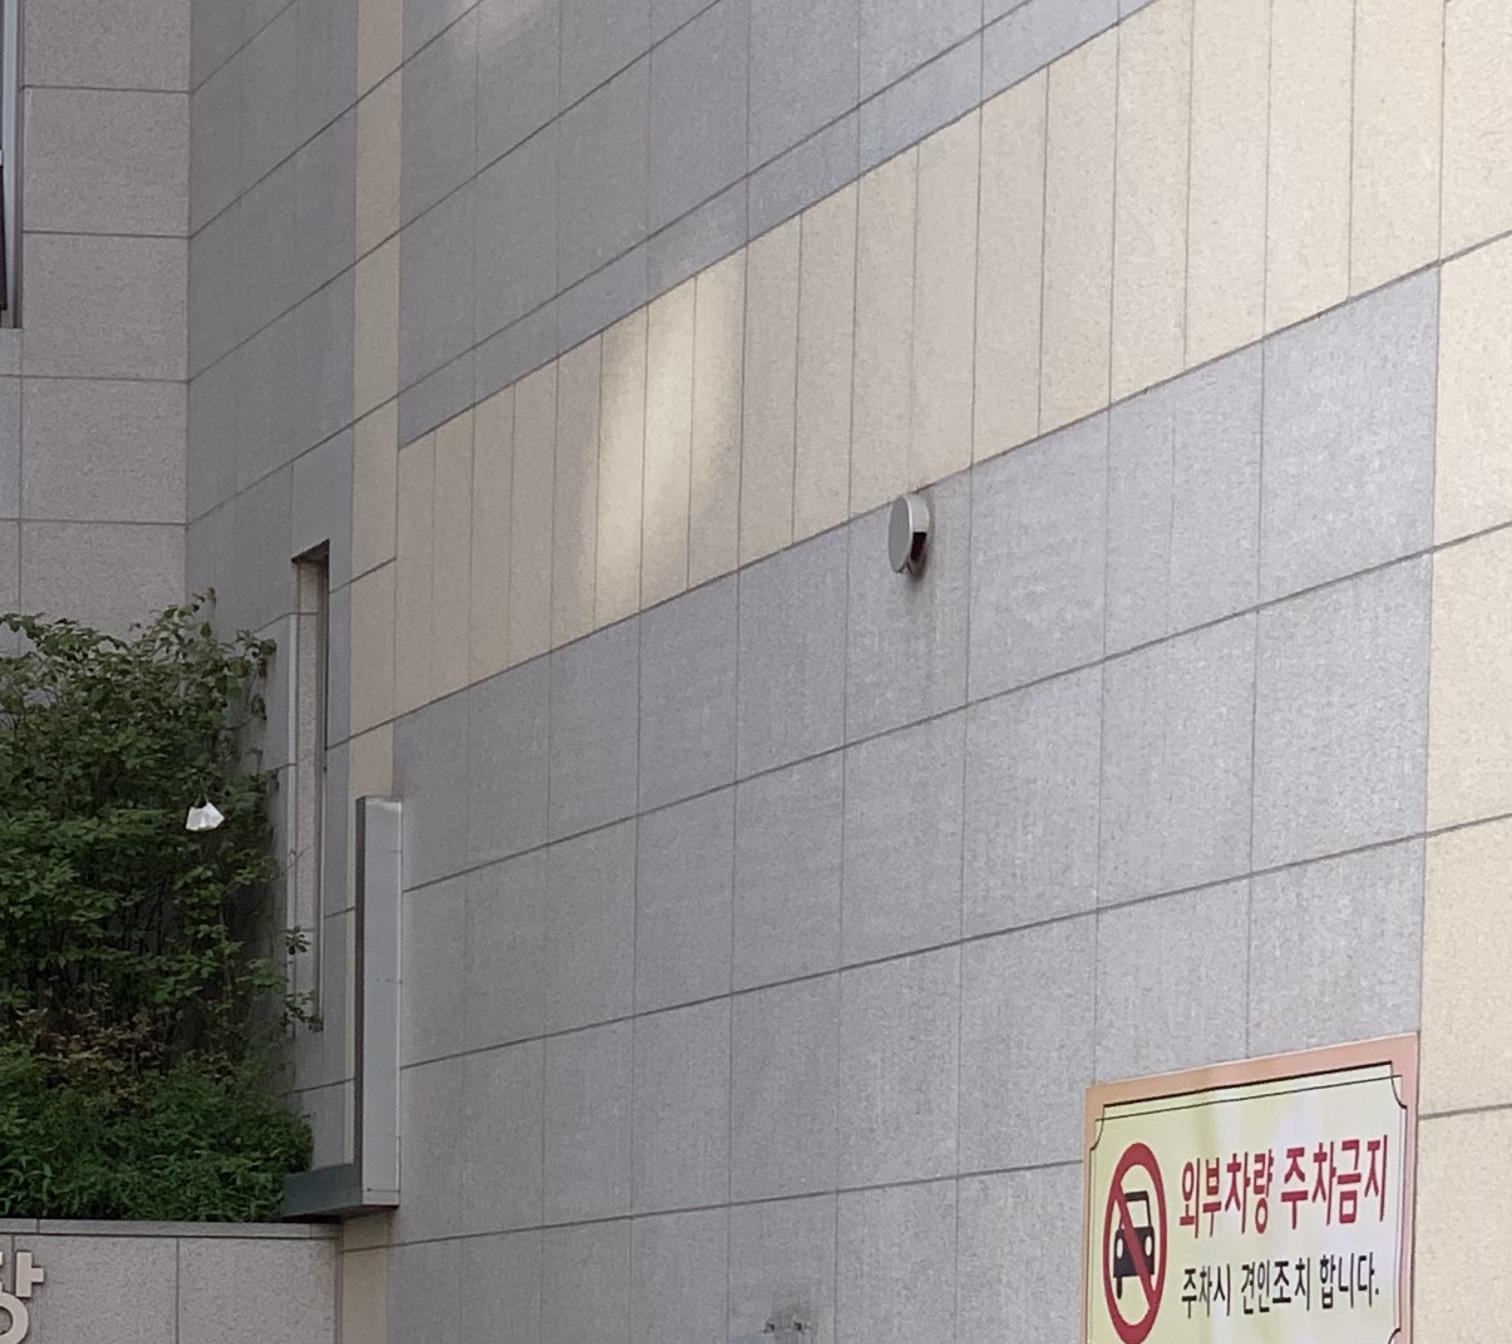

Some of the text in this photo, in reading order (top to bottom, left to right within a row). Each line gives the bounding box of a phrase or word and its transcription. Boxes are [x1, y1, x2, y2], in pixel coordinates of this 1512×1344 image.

[1179, 1134, 1389, 1239] 외부차량 주차금지
[1181, 1251, 1381, 1319] 주차시 견인조치 합니다.
